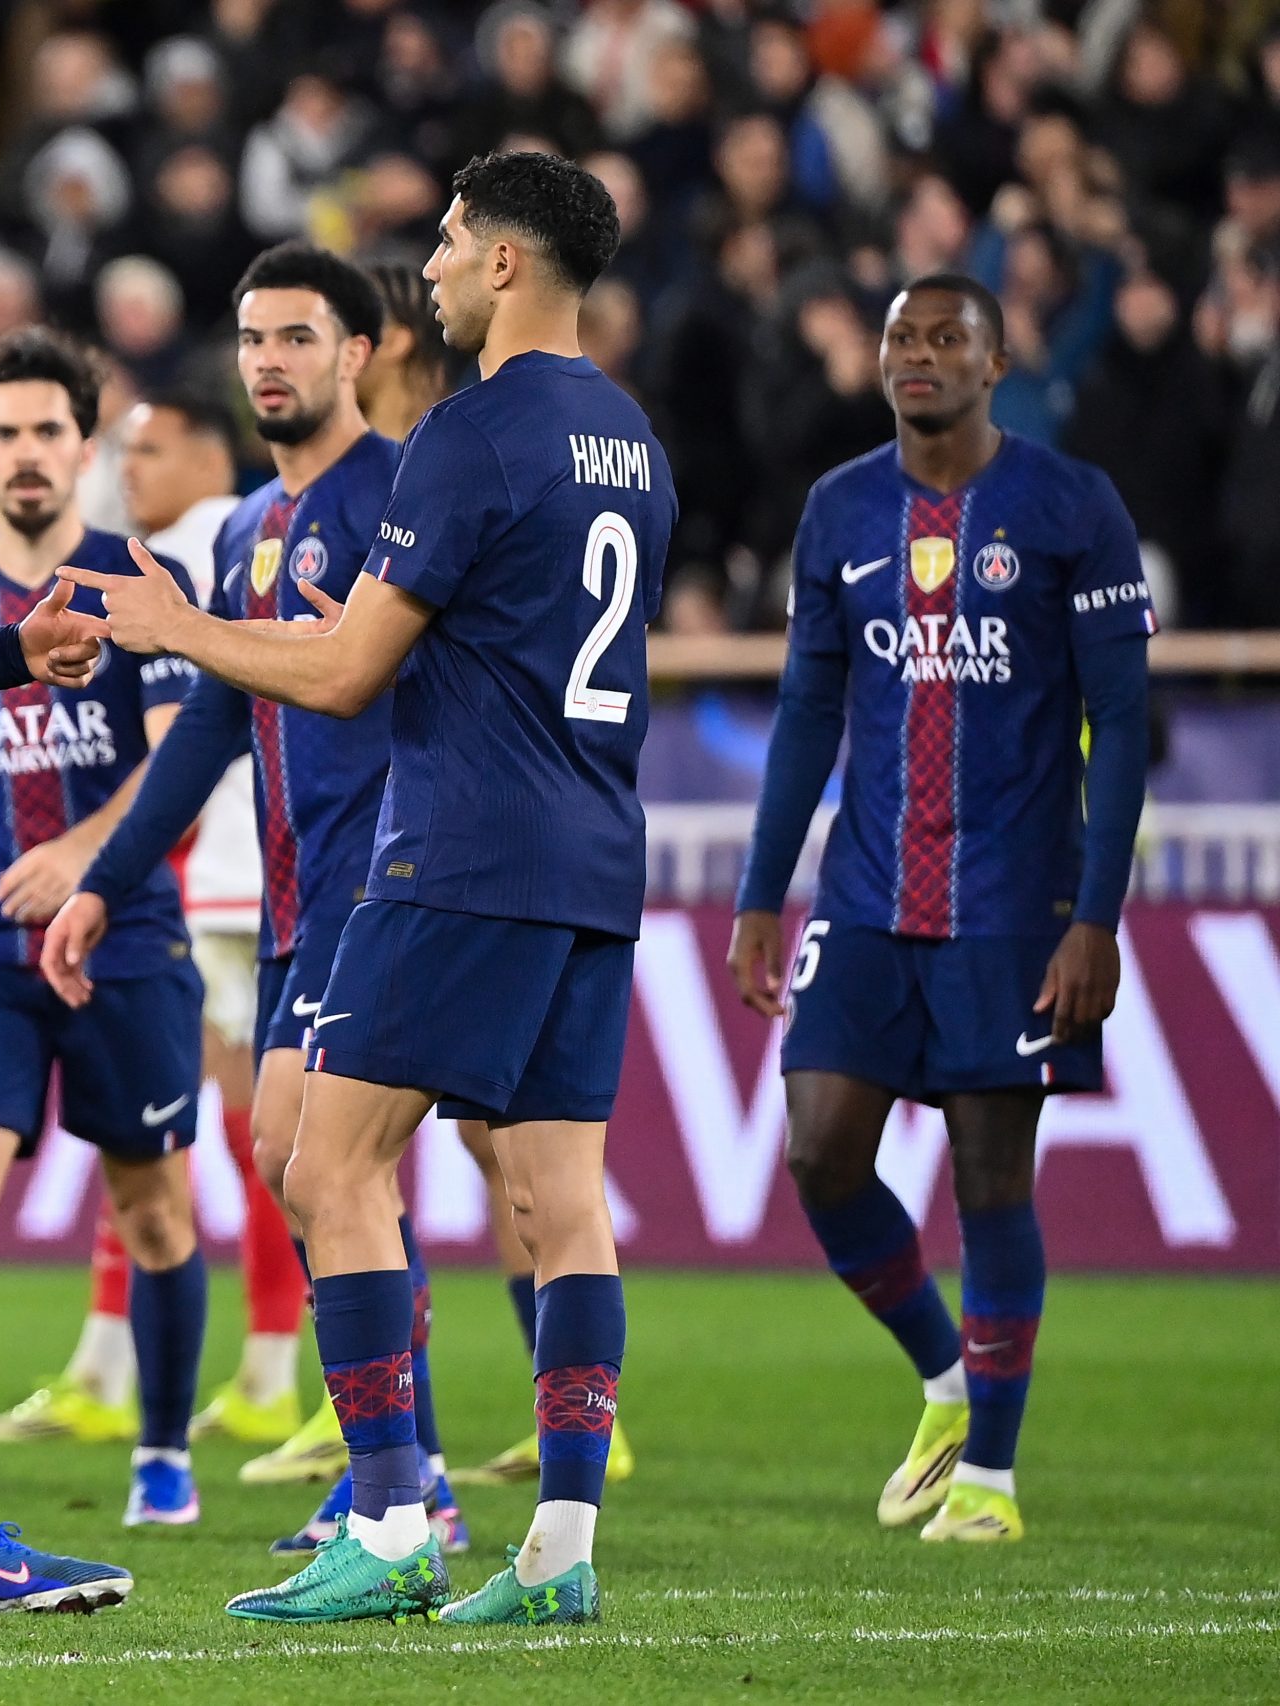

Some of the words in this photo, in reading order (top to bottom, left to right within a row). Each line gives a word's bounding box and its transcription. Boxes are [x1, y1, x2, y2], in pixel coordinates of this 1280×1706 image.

[568, 434, 651, 492] HAKIMI
[563, 510, 638, 724] 2
[1073, 581, 1149, 614] BEYON
[863, 613, 1011, 667] QATAR
[900, 655, 1012, 684] AIRWAYS
